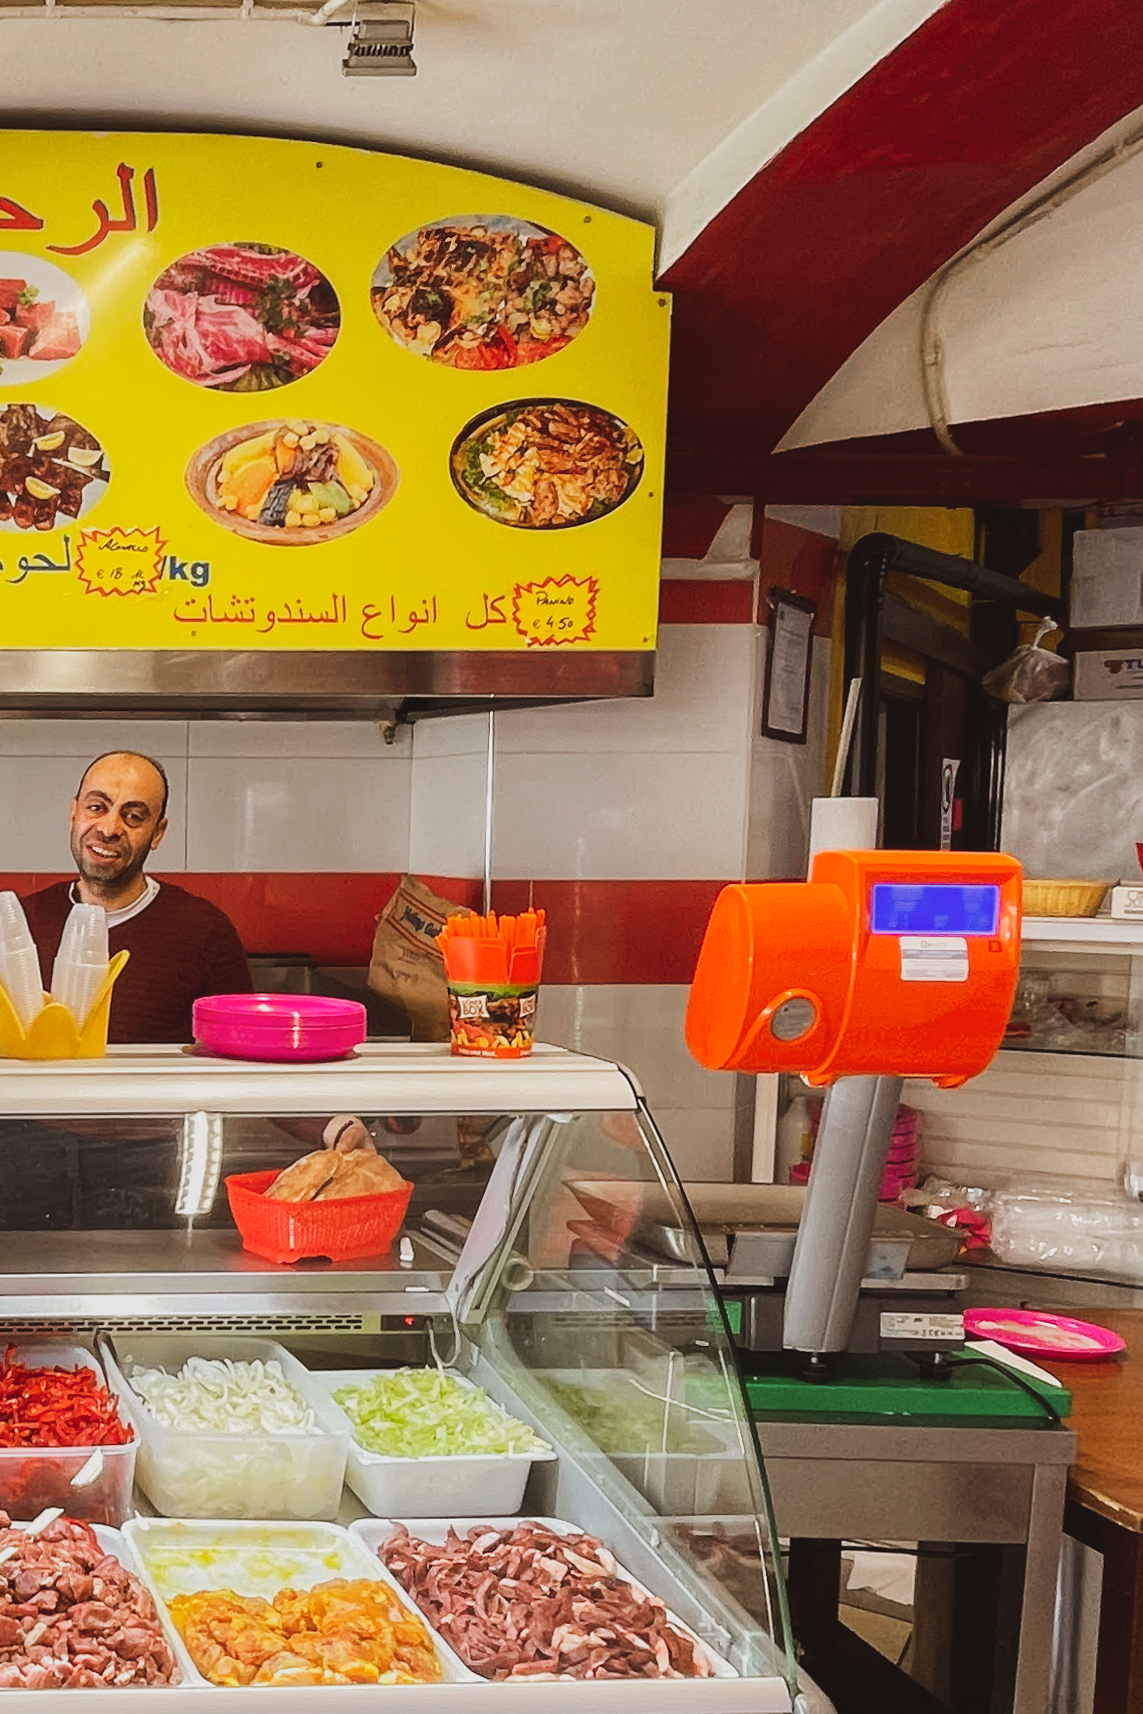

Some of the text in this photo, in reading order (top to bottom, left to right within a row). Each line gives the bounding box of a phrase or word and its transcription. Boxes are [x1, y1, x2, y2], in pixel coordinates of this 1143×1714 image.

[109, 567, 123, 579] 18
[360, 594, 438, 640] انواع
[465, 593, 508, 629] كل
